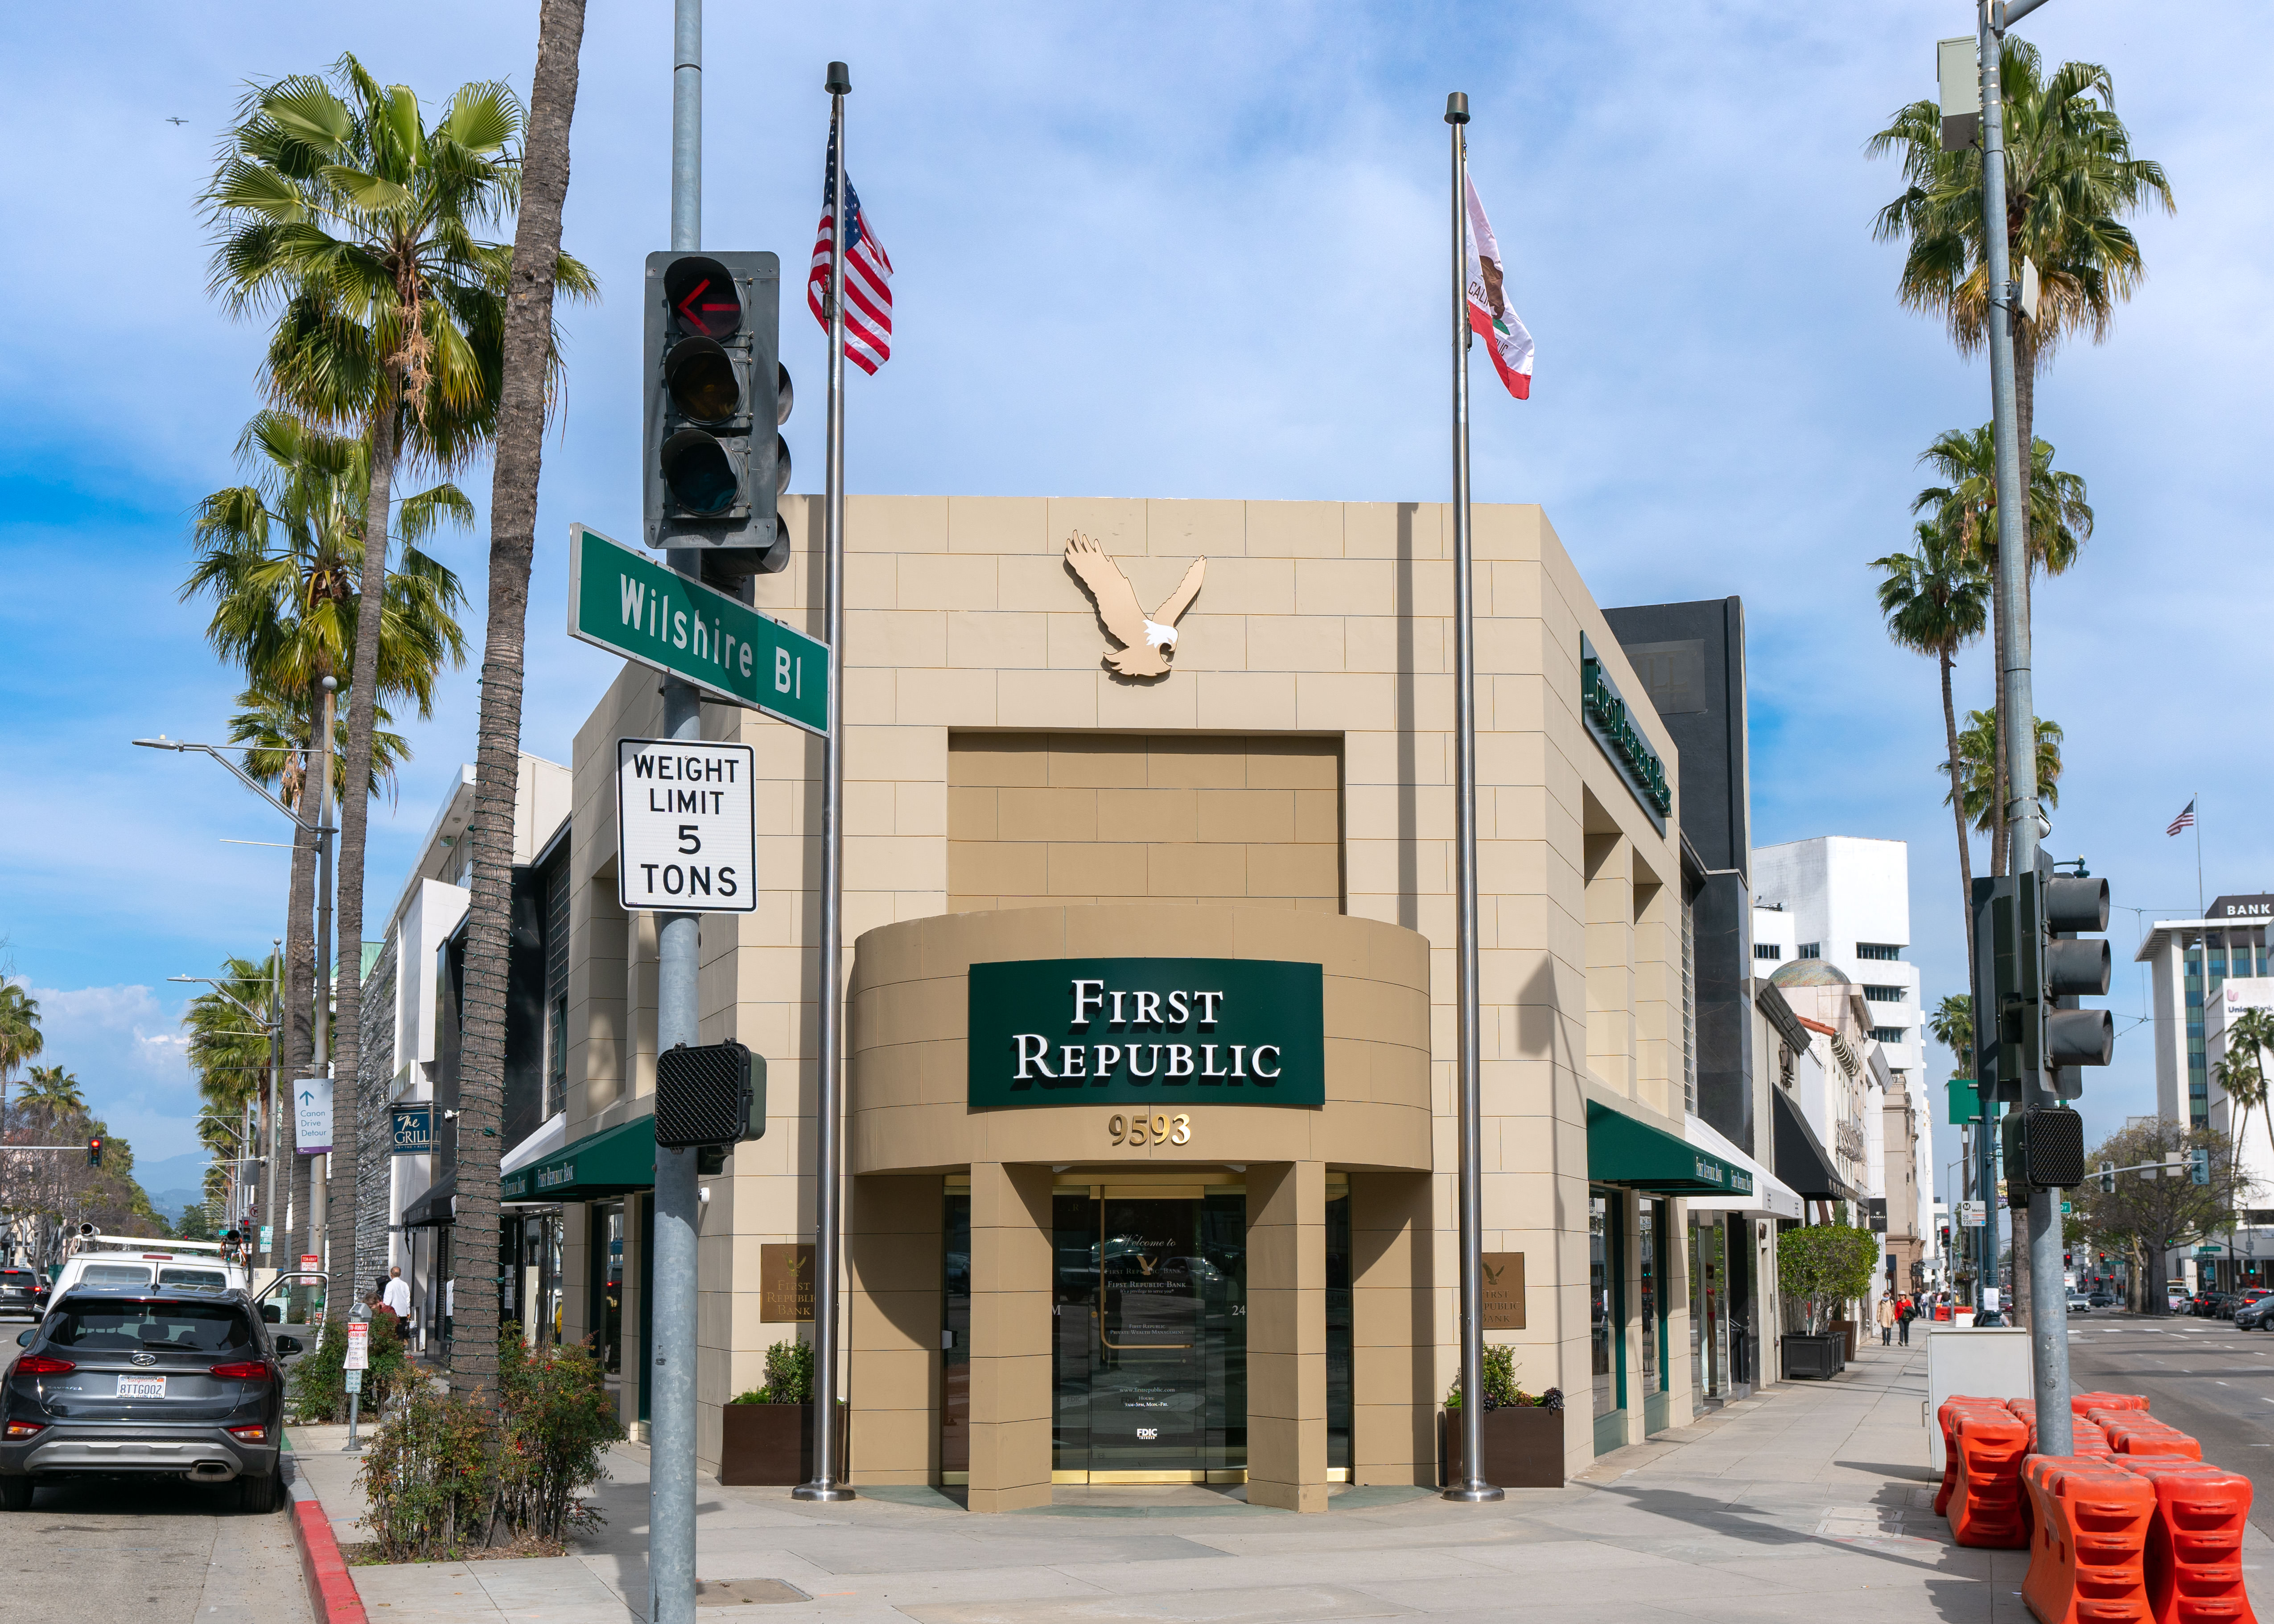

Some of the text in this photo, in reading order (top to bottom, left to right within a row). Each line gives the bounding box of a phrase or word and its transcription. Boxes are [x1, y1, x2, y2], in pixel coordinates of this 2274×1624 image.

[620, 573, 801, 700] Wilshire Bl
[633, 753, 739, 783] WEIGHT
[650, 788, 724, 815] LIMIT
[678, 825, 701, 855] 5
[640, 863, 737, 897] TONS
[2227, 904, 2270, 915] BANK
[1071, 979, 1224, 1024] FIRST
[1012, 1034, 1281, 1079] REPUBLIC
[397, 1115, 420, 1131] The
[1108, 1113, 1191, 1147] 9593
[394, 1130, 430, 1144] GRILL
[1117, 1234, 1176, 1247] Welcome to
[778, 1280, 810, 1290] FIRST
[766, 1292, 816, 1303] REPUBLI
[778, 1305, 811, 1315] BANK
[1232, 1305, 1246, 1316] 24
[1483, 1301, 1520, 1310] PUBLIC
[120, 1384, 162, 1394] 8TTG002
